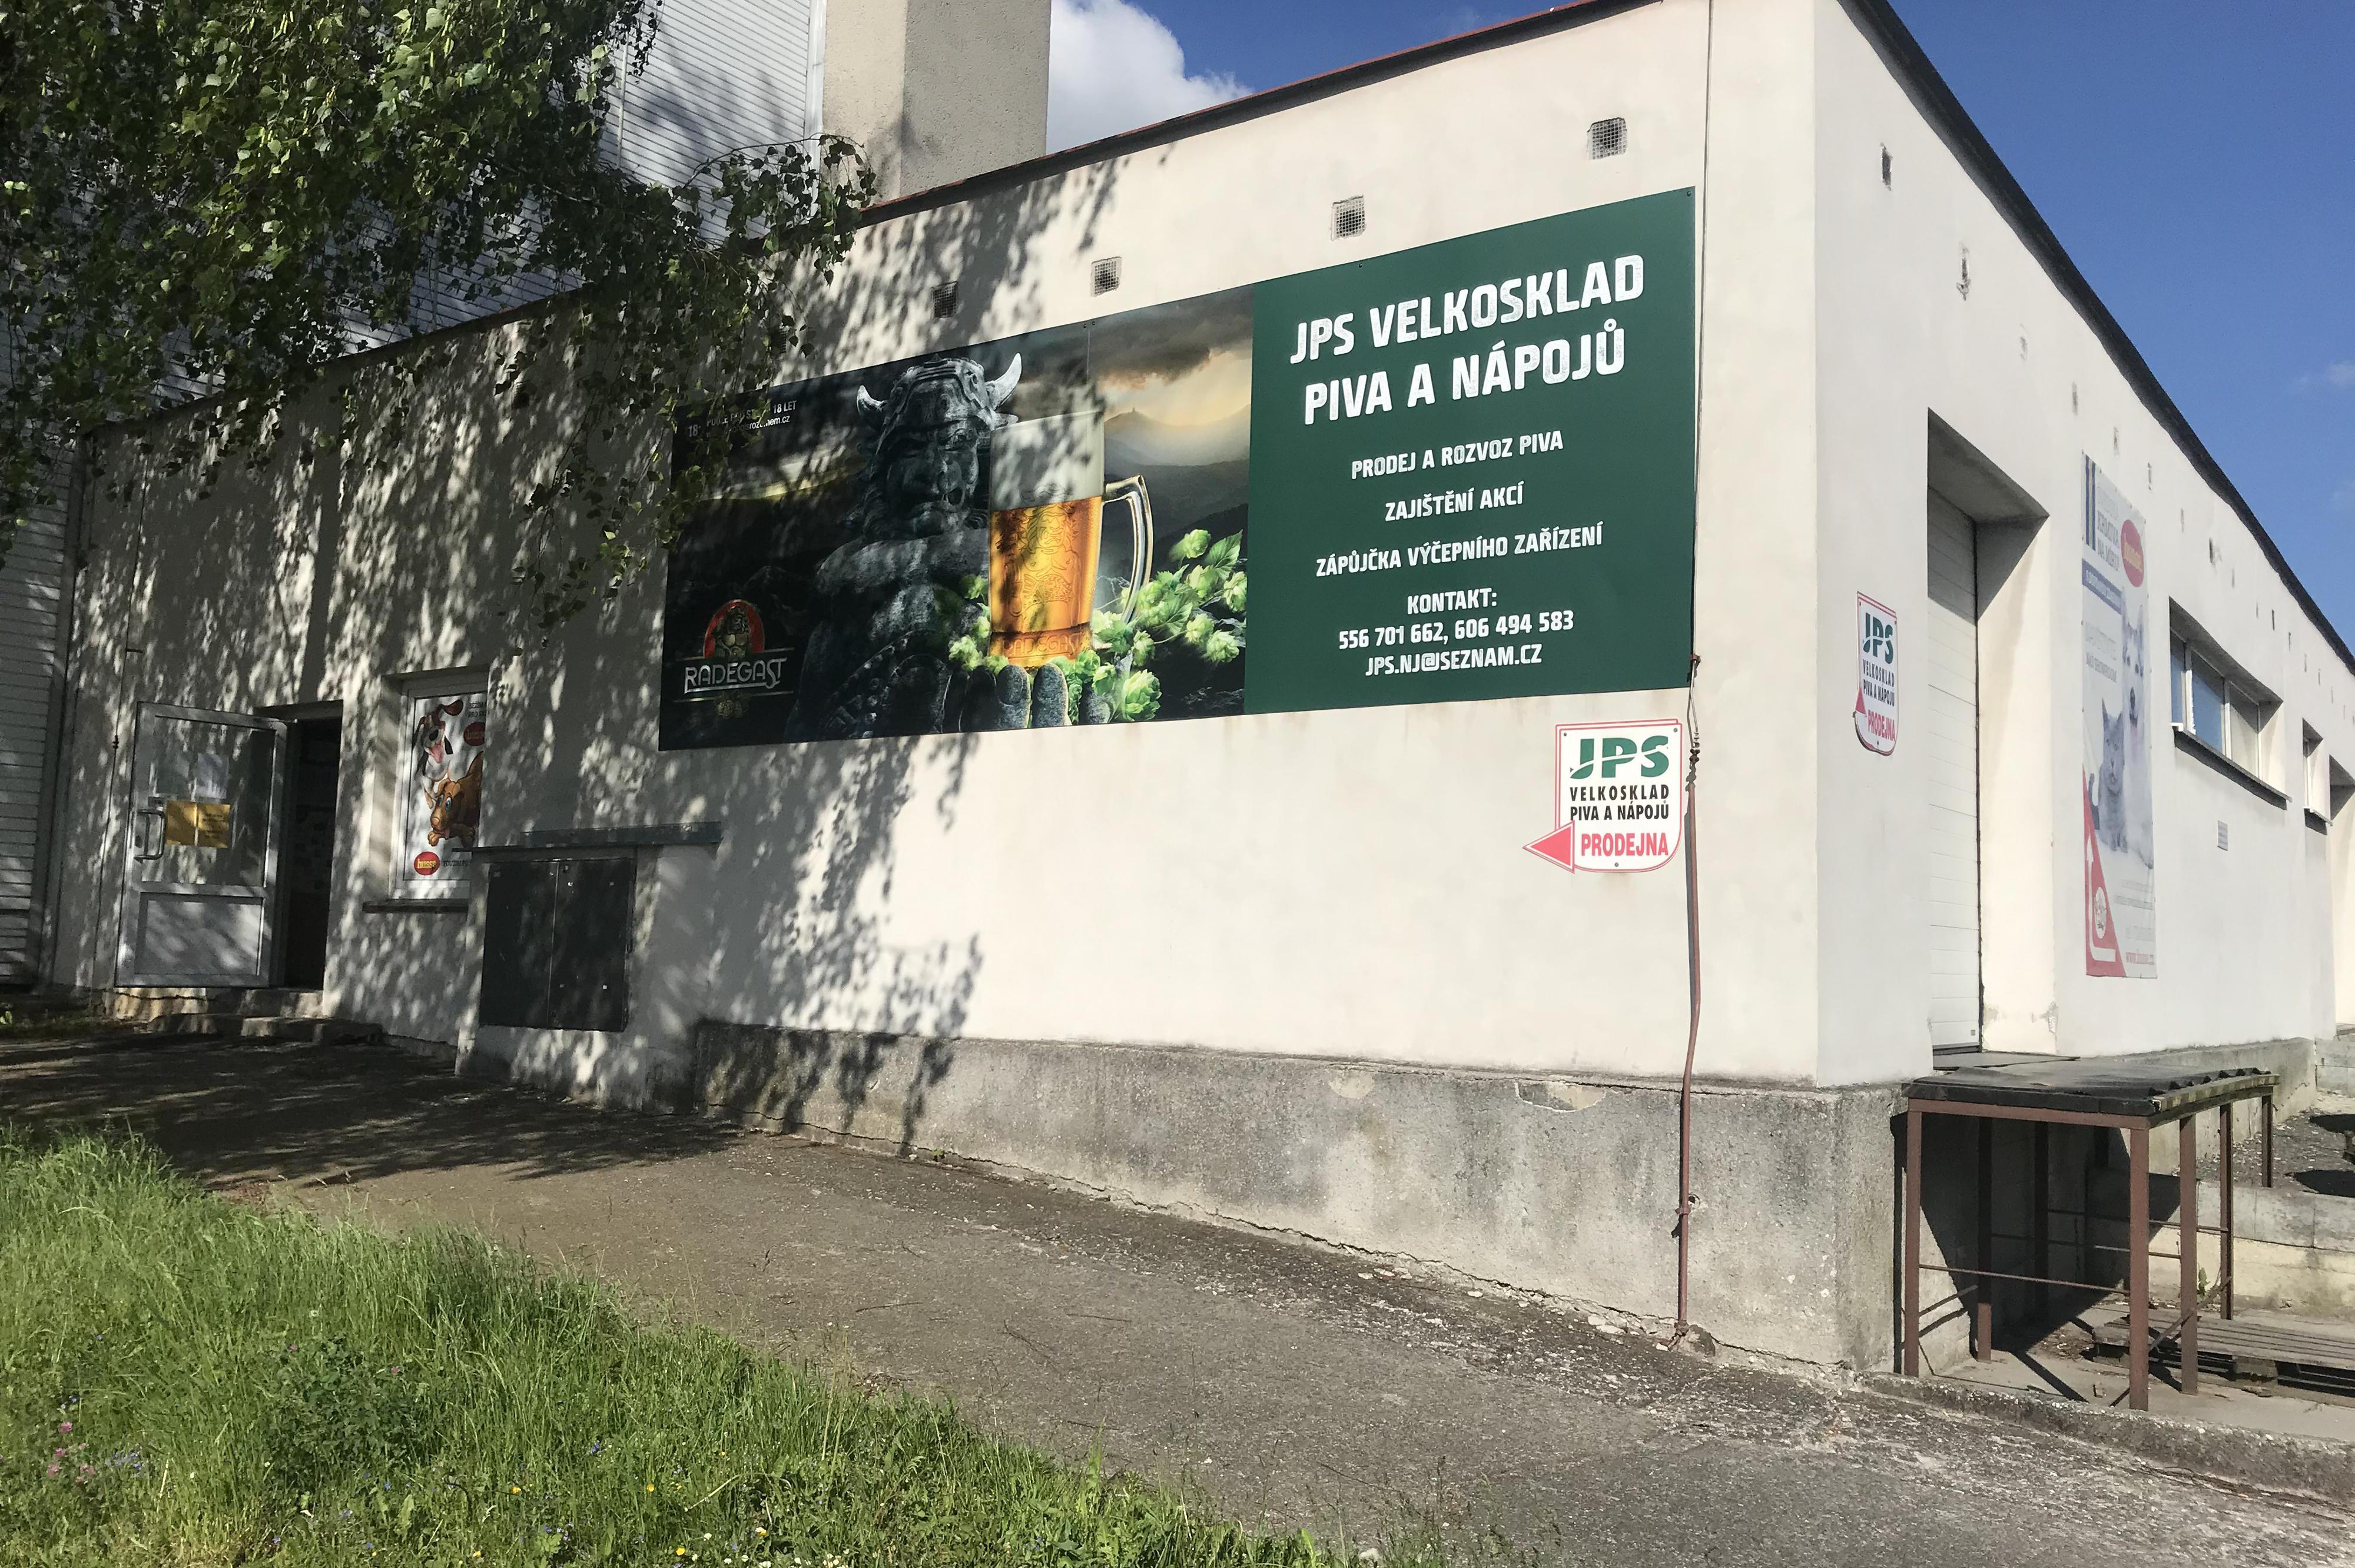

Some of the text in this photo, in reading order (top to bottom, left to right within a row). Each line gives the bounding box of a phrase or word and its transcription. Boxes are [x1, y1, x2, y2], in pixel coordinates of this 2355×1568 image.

[1290, 254, 1644, 364] JPS VELKOSKLAD
[1305, 318, 1625, 425] PIVA A NÁPOJŮ
[772, 403, 782, 414] 18
[784, 401, 797, 412] LET
[1352, 430, 1564, 480] PRODEJ A ROZVOZ PIVA
[1385, 480, 1524, 521] ZAJIŠTĚNÍ AKCÍ
[1316, 520, 1604, 577] ZÁPŮJČKA VÝČEPNÍHO ZAŘÍZENÍ
[1408, 587, 1497, 614] KONTAKT:
[1339, 610, 1574, 650] 556 701 662, 606 494 583
[1863, 612, 1893, 664] JPS
[684, 657, 787, 695] RADEGAST
[1365, 643, 1543, 676] JPS.NJ@SEZNAM.CZ
[1863, 659, 1895, 687] VELKOSKLAD
[1863, 679, 1873, 698] PIVA
[1873, 684, 1877, 700] A
[1868, 709, 1895, 741] PRODEJNA
[1570, 735, 1669, 779] JPS
[1570, 784, 1669, 802] VELKOSKLAD
[1570, 799, 1669, 821] PIVA A NÁPOJŮ
[1581, 832, 1669, 856] PRODEJNA
